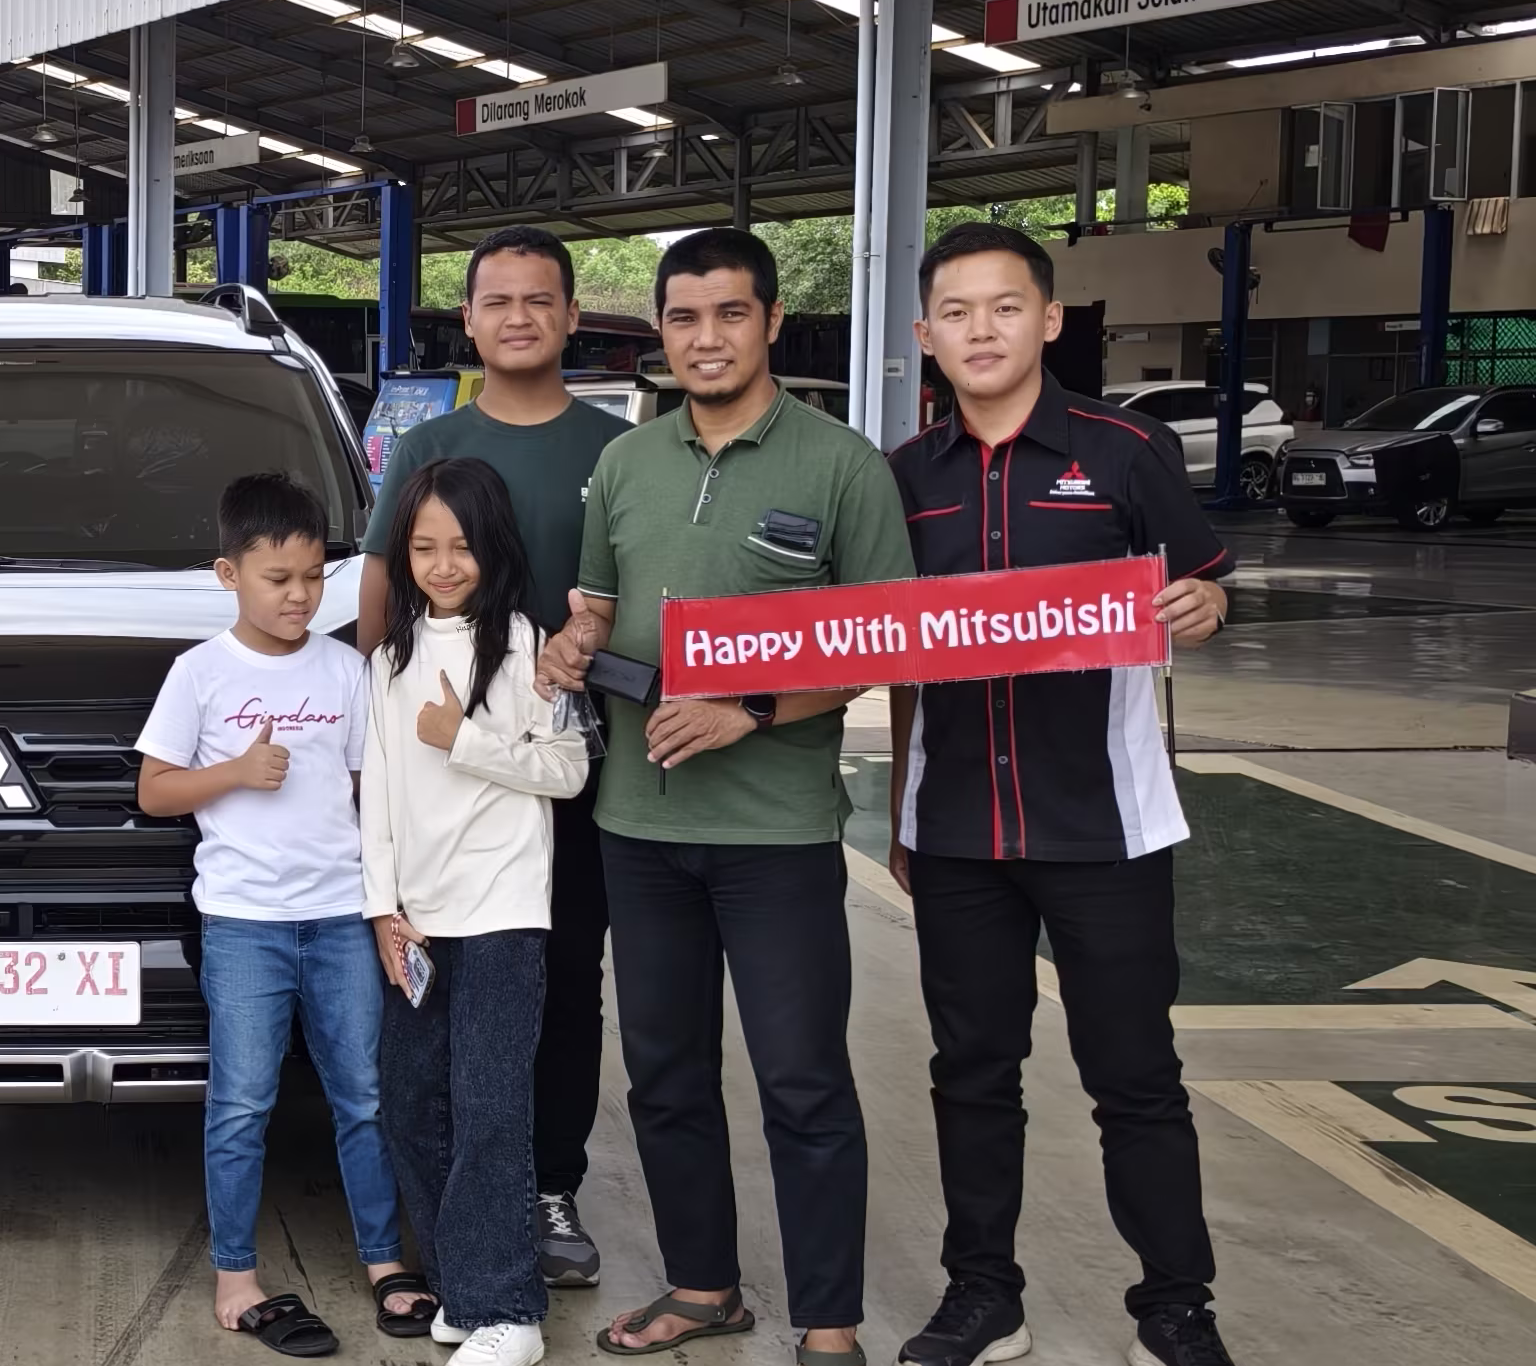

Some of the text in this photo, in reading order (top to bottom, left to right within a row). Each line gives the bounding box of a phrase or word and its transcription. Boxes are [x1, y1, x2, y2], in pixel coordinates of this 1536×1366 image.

[481, 86, 587, 124] Dilarang Merokok
[684, 591, 1137, 667] Happy With Mitsubishi
[224, 696, 345, 730] Giordano
[75, 950, 128, 996] XI
